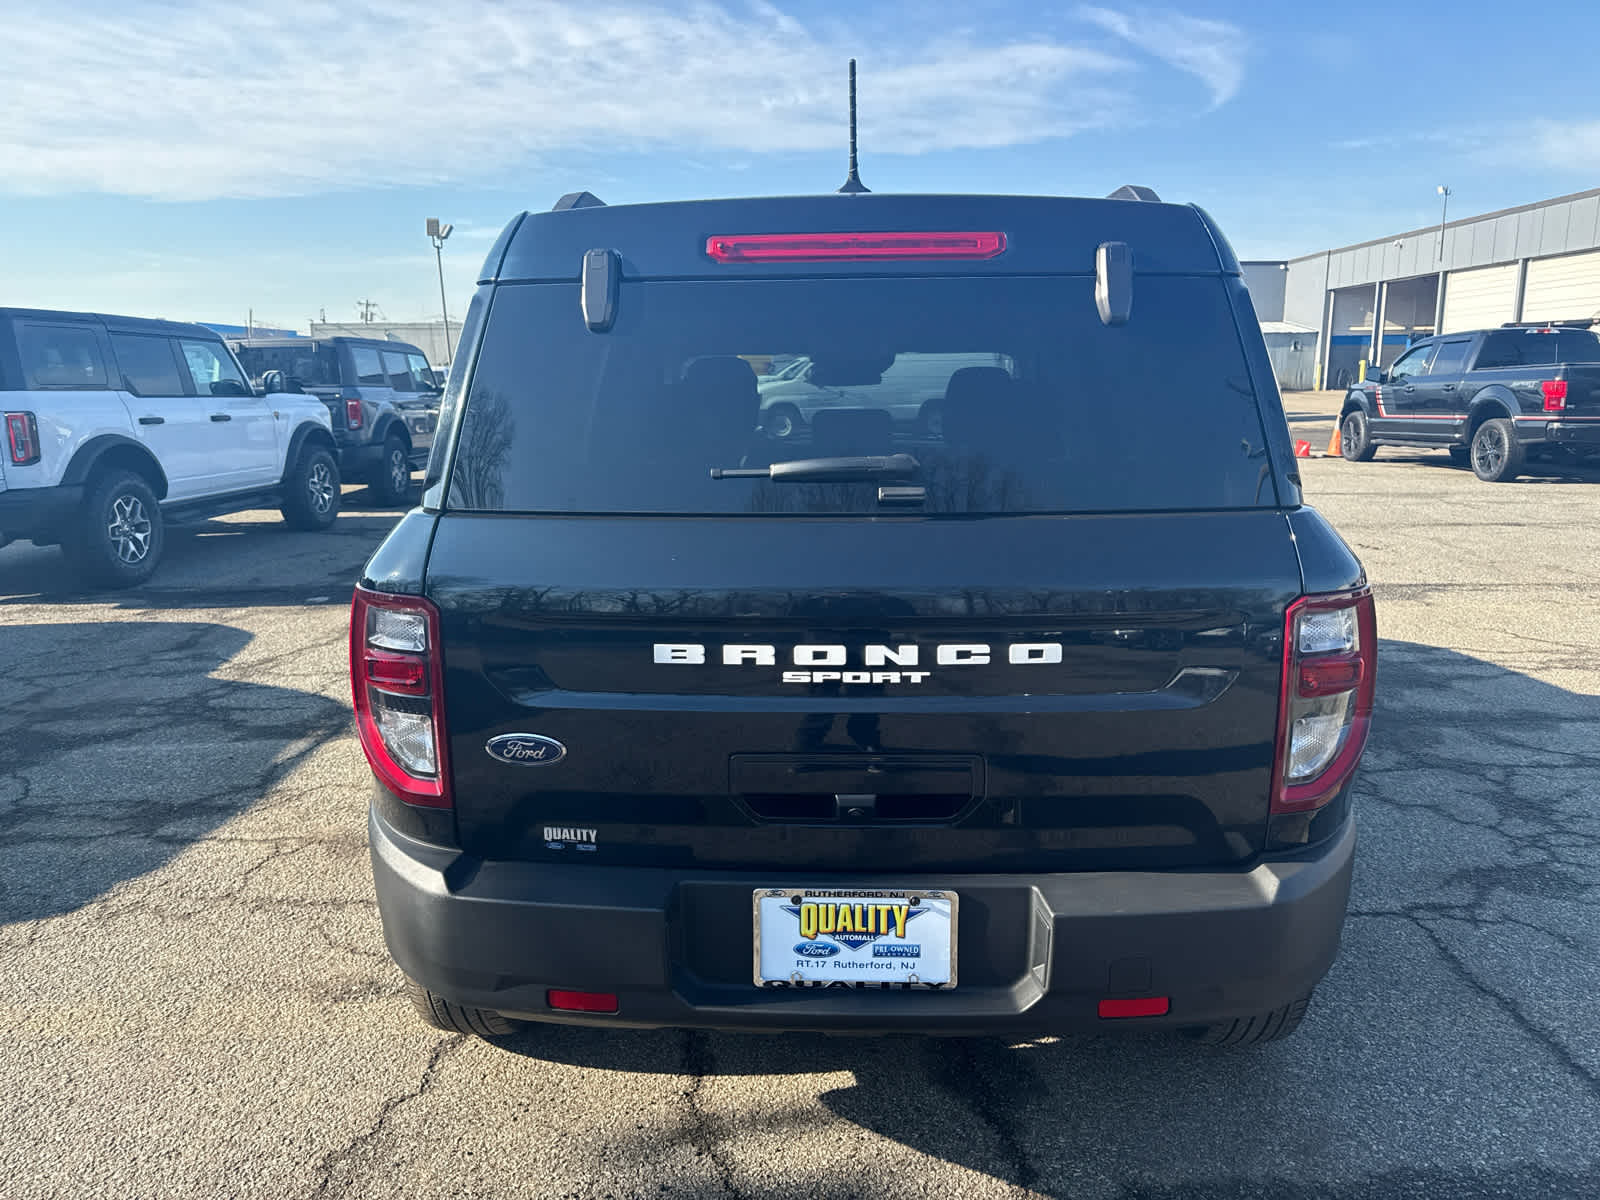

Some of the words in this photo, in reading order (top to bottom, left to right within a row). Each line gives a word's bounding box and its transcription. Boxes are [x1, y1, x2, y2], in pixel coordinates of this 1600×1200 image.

[653, 643, 1063, 665] BRONCO
[782, 671, 931, 684] SPORT
[503, 740, 546, 759] Ford
[543, 826, 598, 843] QUALITY
[889, 891, 905, 899] NJ
[800, 903, 910, 939] QUALITY
[801, 943, 831, 957] Ford
[796, 960, 827, 969] RT.17
[833, 960, 896, 971] Rutherford,
[900, 961, 916, 970] NJ
